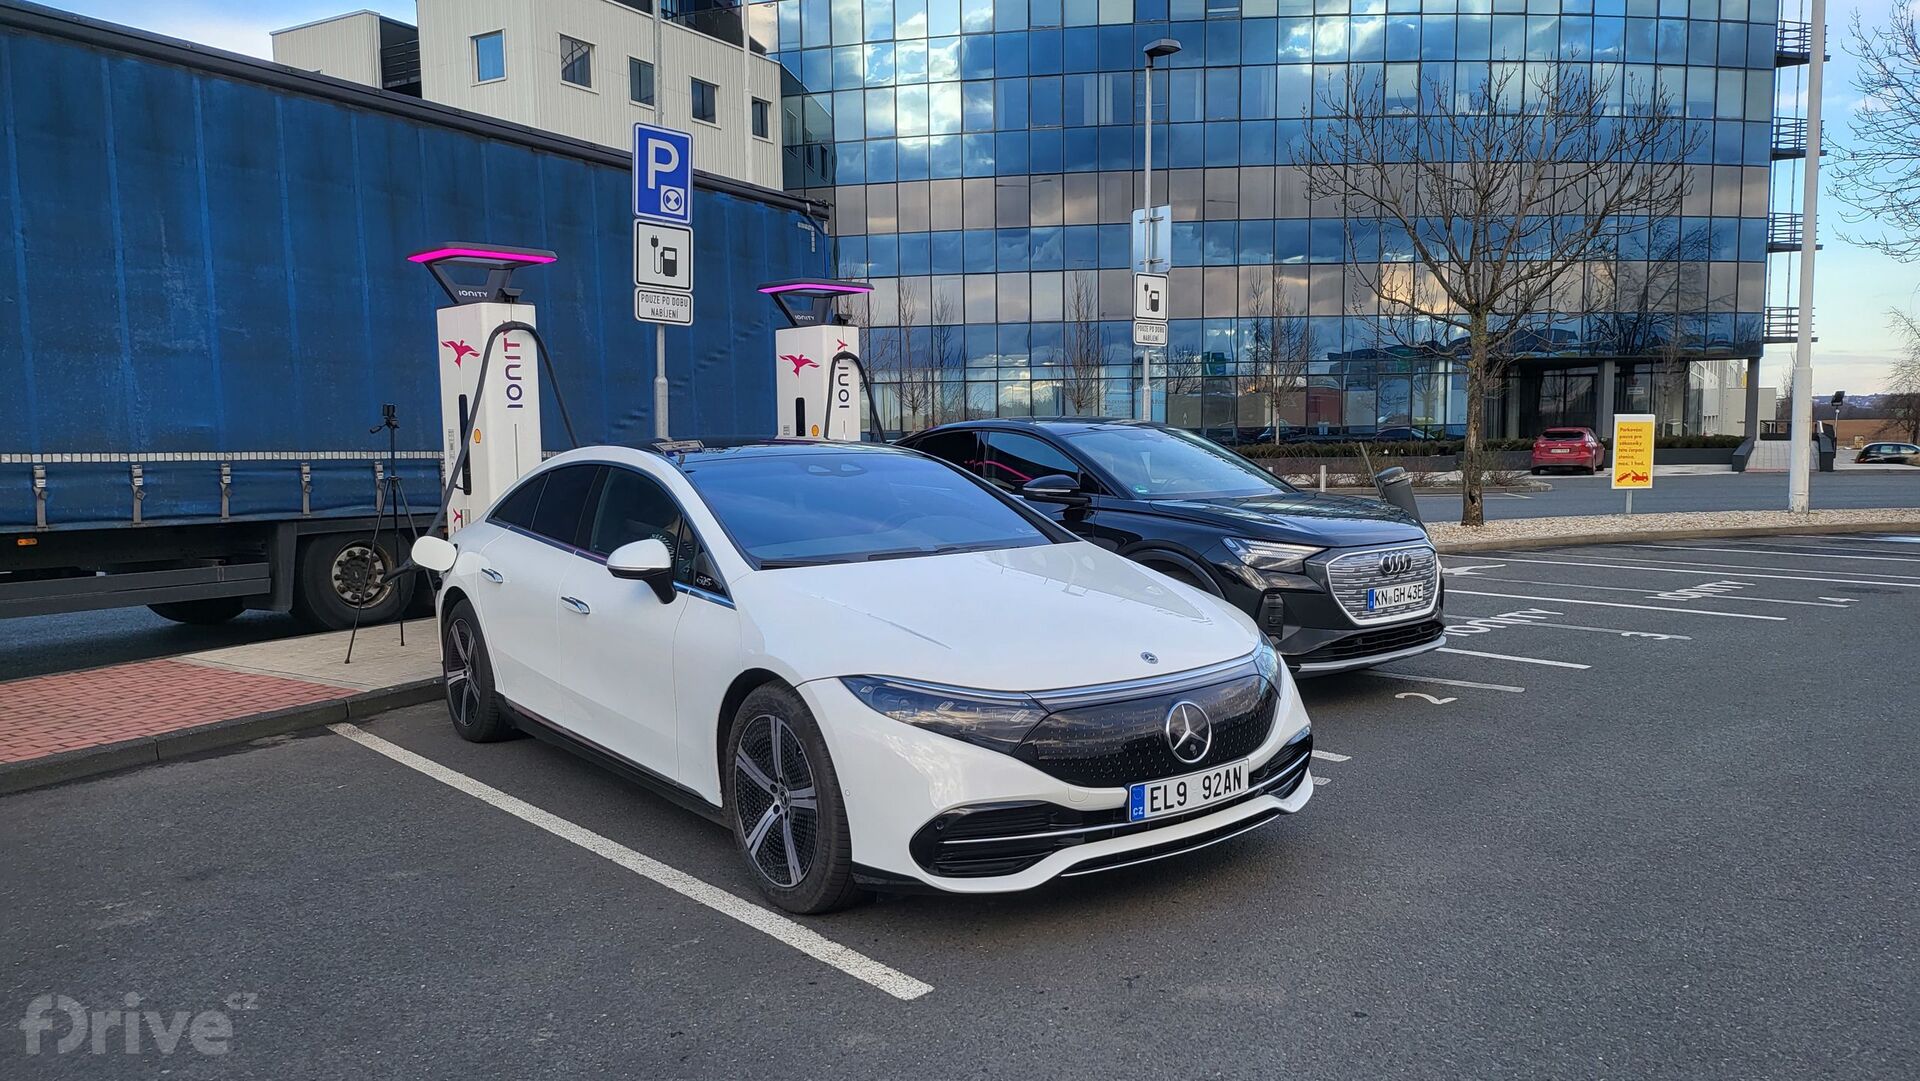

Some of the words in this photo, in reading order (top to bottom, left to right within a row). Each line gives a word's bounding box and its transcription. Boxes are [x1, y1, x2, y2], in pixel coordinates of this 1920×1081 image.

[647, 137, 680, 190] P
[640, 293, 661, 305] POUZE
[661, 295, 671, 306] PO
[1375, 590, 1388, 606] KN
[1393, 587, 1406, 603] GH
[1407, 584, 1423, 600] 43E
[1149, 781, 1188, 813] EL9
[1201, 765, 1243, 800] 92AN
[1132, 806, 1144, 816] CZ
